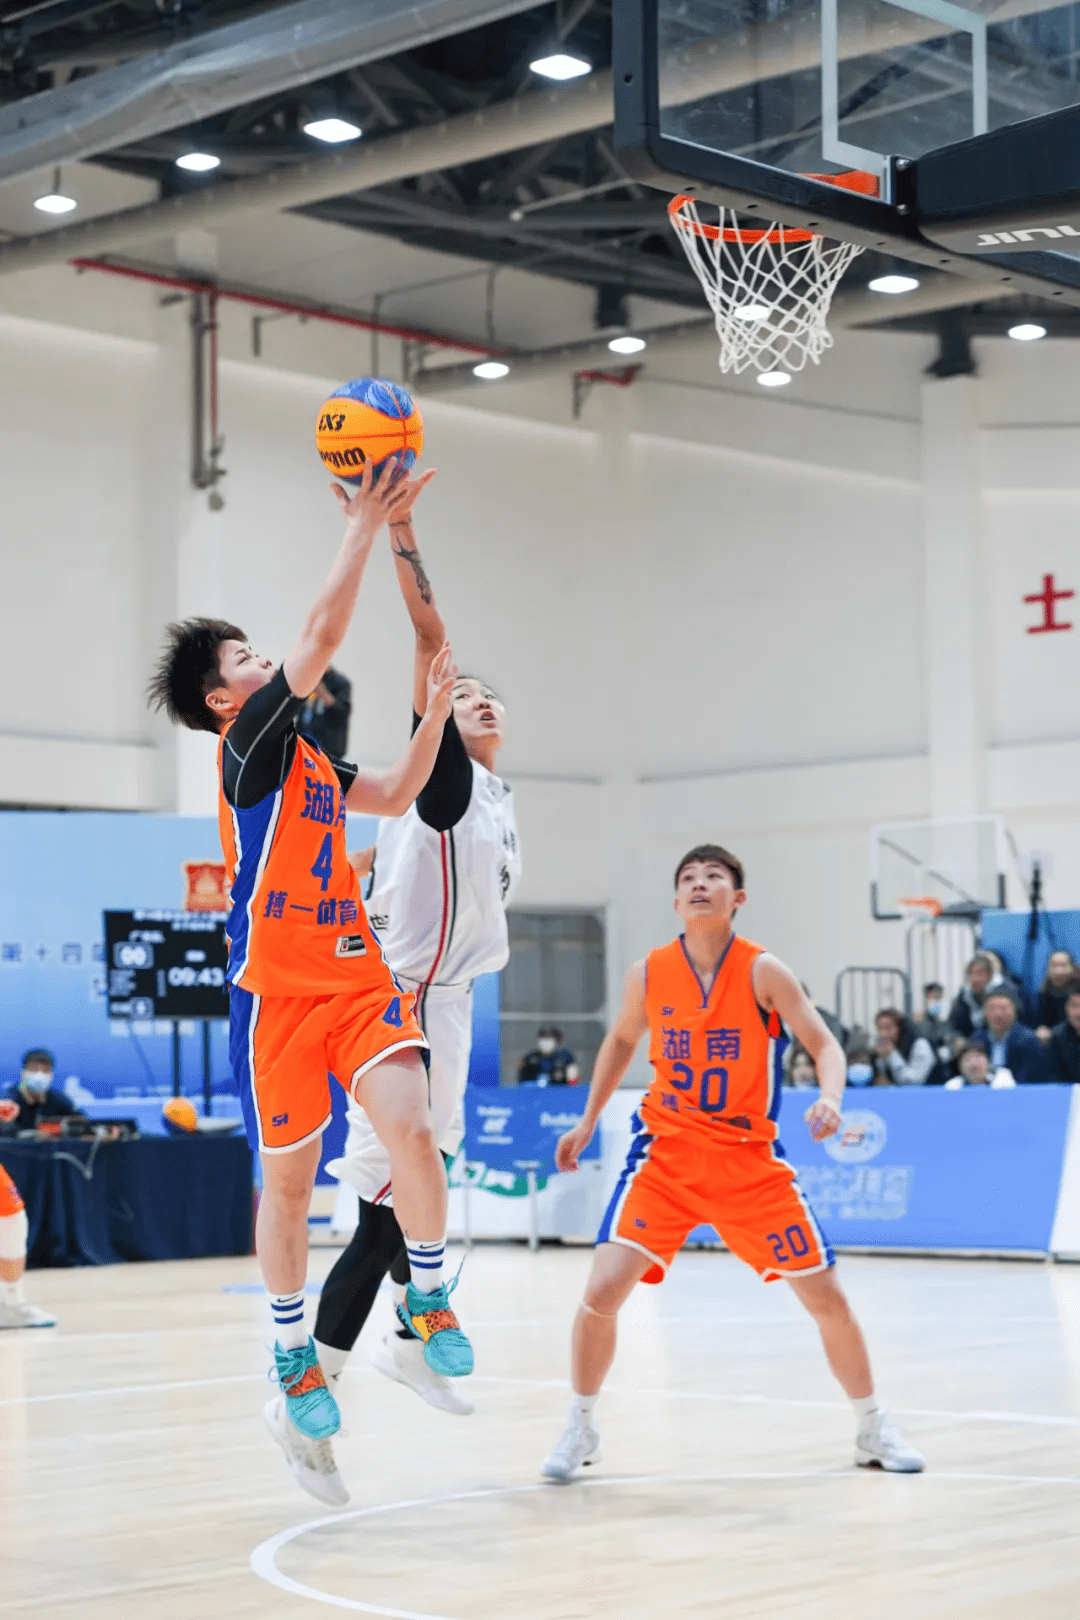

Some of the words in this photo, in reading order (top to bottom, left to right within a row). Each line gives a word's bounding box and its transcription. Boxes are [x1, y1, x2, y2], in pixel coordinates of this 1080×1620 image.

[311, 832, 332, 891] 4
[382, 996, 403, 1028] 4
[661, 1026, 742, 1061] 湖南
[668, 1061, 729, 1113] 20
[767, 1224, 809, 1263] 20
